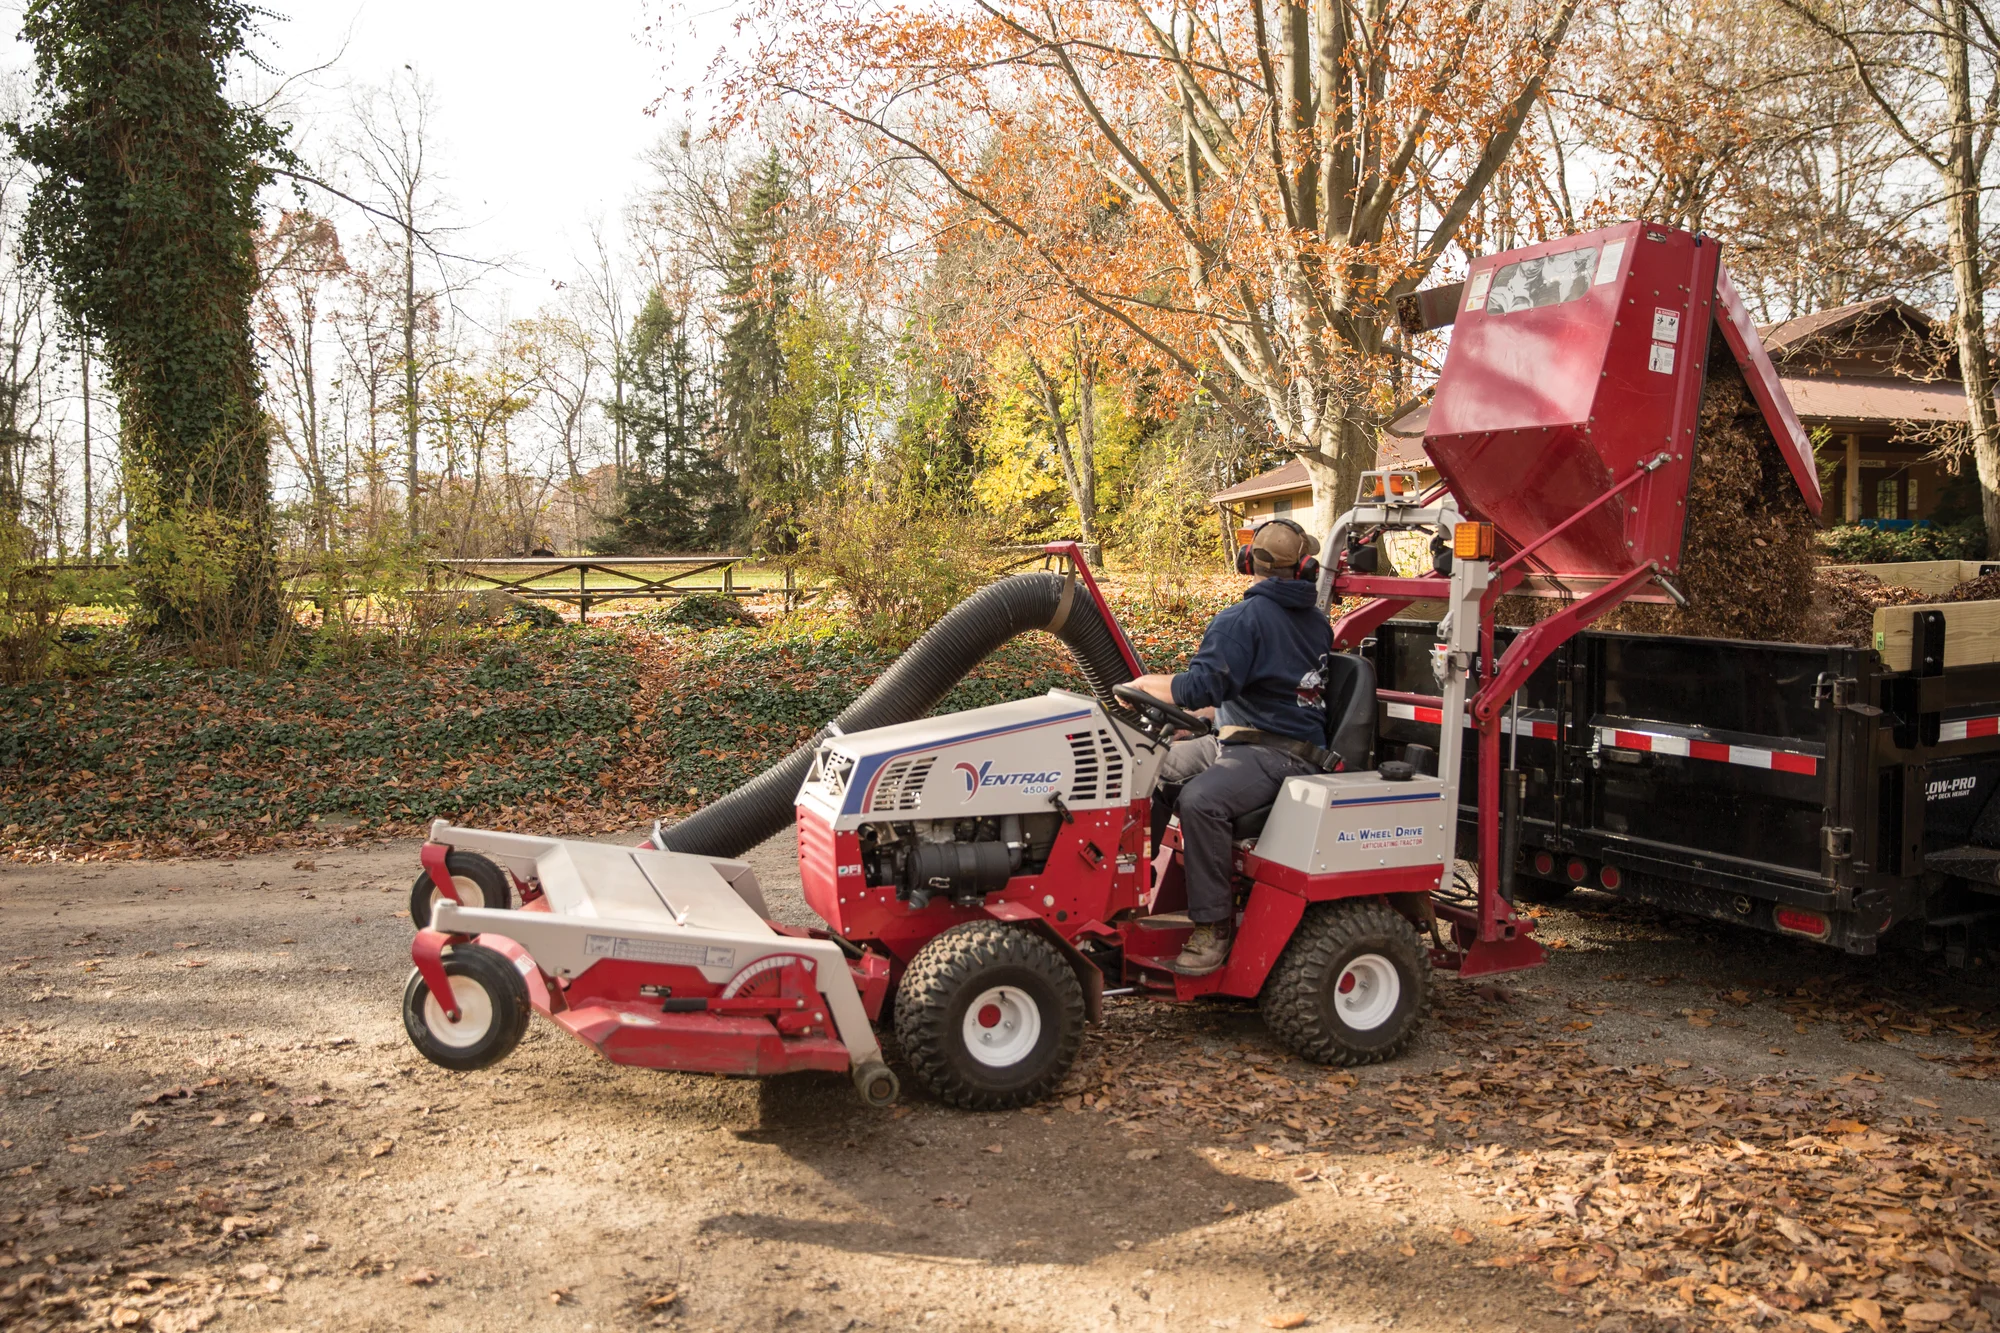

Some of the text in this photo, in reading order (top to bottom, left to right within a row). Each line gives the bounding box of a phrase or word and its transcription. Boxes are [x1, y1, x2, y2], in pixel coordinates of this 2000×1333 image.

[966, 760, 1061, 791] VENTRAC
[1023, 785, 1055, 794] 4500P
[1938, 792, 1951, 800] DECK
[1952, 789, 1970, 797] HEIGHT
[1337, 827, 1423, 842] ALL WHEEL DRIVE
[1362, 838, 1423, 849] ARTICULATING TRACTOR
[838, 864, 862, 876] DFI
